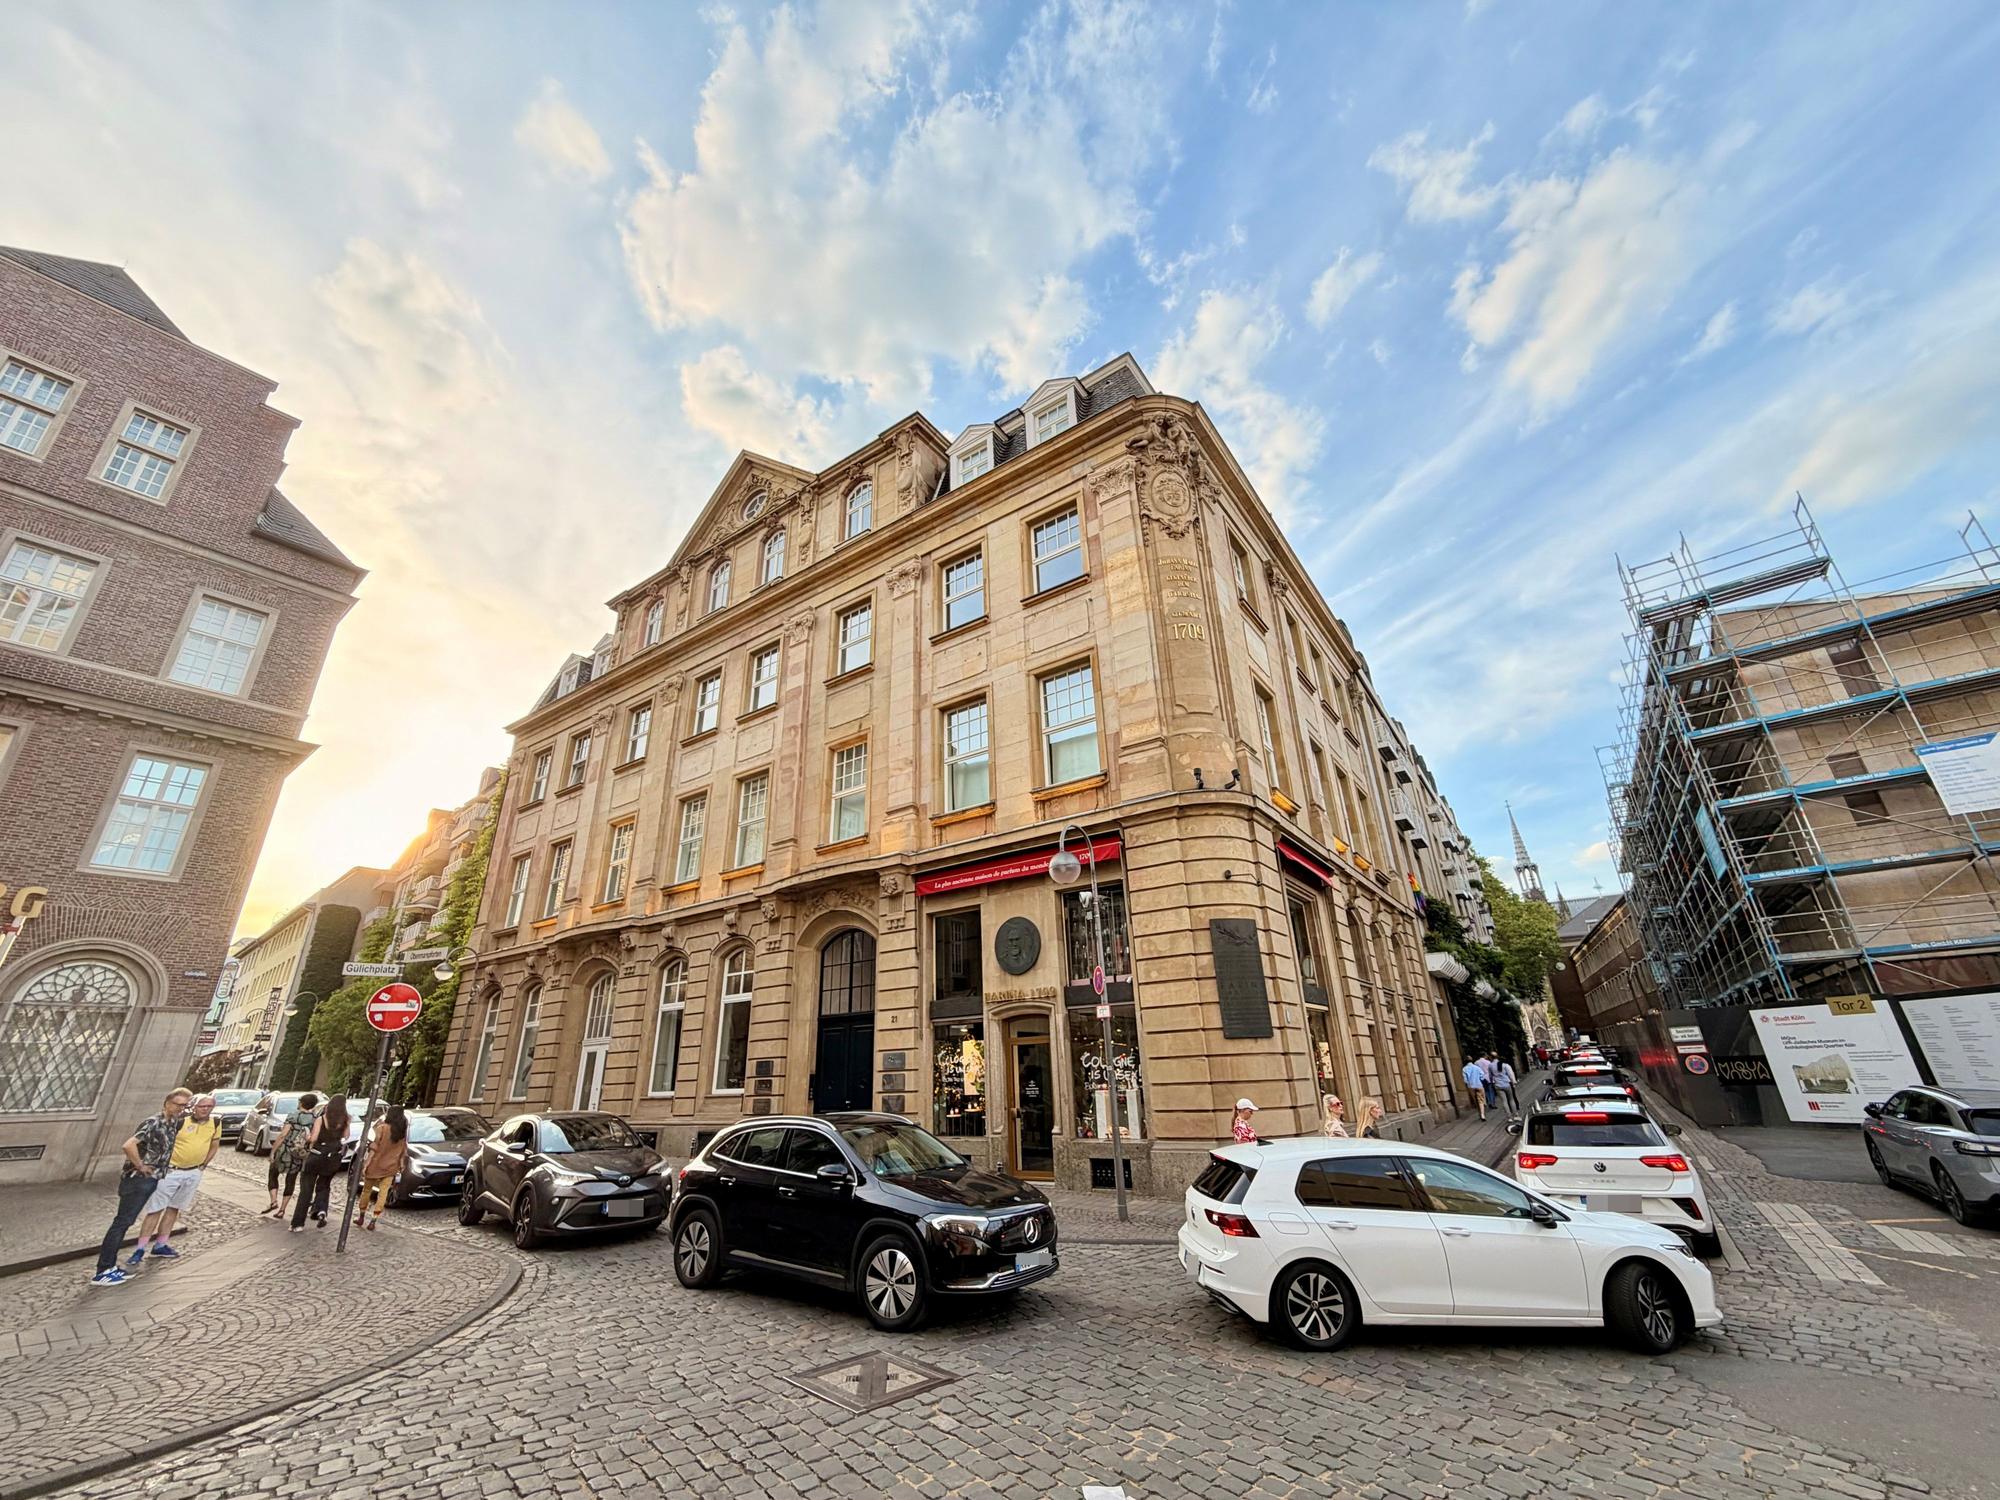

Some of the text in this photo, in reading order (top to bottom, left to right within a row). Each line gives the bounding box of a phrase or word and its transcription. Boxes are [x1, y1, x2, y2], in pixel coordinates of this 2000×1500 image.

[1172, 623, 1205, 640] 1709
[942, 880, 951, 888] plus
[952, 876, 974, 885] ancienne
[974, 873, 992, 881] maison
[1000, 867, 1021, 877] parfum
[346, 964, 396, 975] Gülichplatz
[1833, 999, 1867, 1010] Tor 2
[1081, 1052, 1136, 1068] COLGNE
